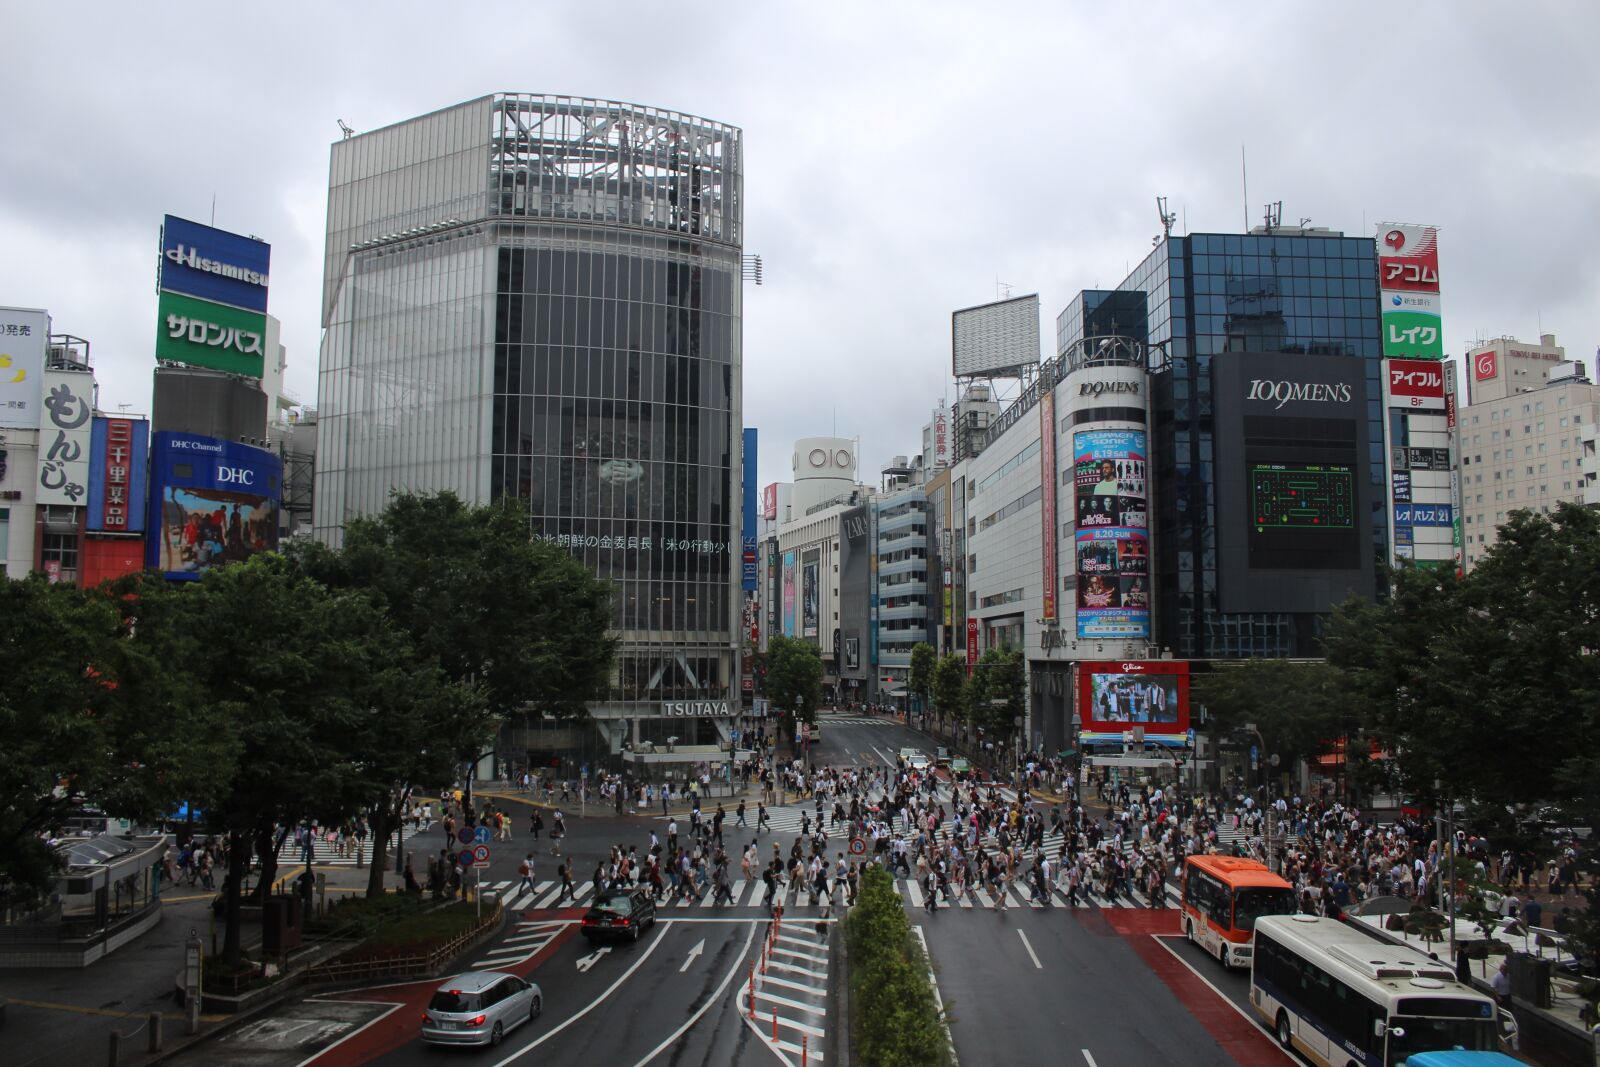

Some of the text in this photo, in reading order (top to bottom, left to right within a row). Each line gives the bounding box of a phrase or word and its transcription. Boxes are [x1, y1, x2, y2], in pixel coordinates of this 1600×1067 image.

[166, 244, 269, 287] Hisamitsu
[1385, 262, 1438, 283] アコム
[1404, 297, 1431, 307] 新生銀行
[167, 313, 263, 356] サロンパス
[1389, 324, 1437, 345] レイク
[1391, 370, 1440, 387] アイフル
[1411, 398, 1424, 406] 8F
[40, 383, 90, 502] もんじゃ
[935, 413, 946, 455] 大和証券
[171, 440, 222, 452] DHC Channel
[106, 422, 129, 525] 三千里薬品
[217, 466, 254, 485] DHC
[1122, 663, 1145, 673] Glico
[665, 702, 729, 716] TSUTAYA
